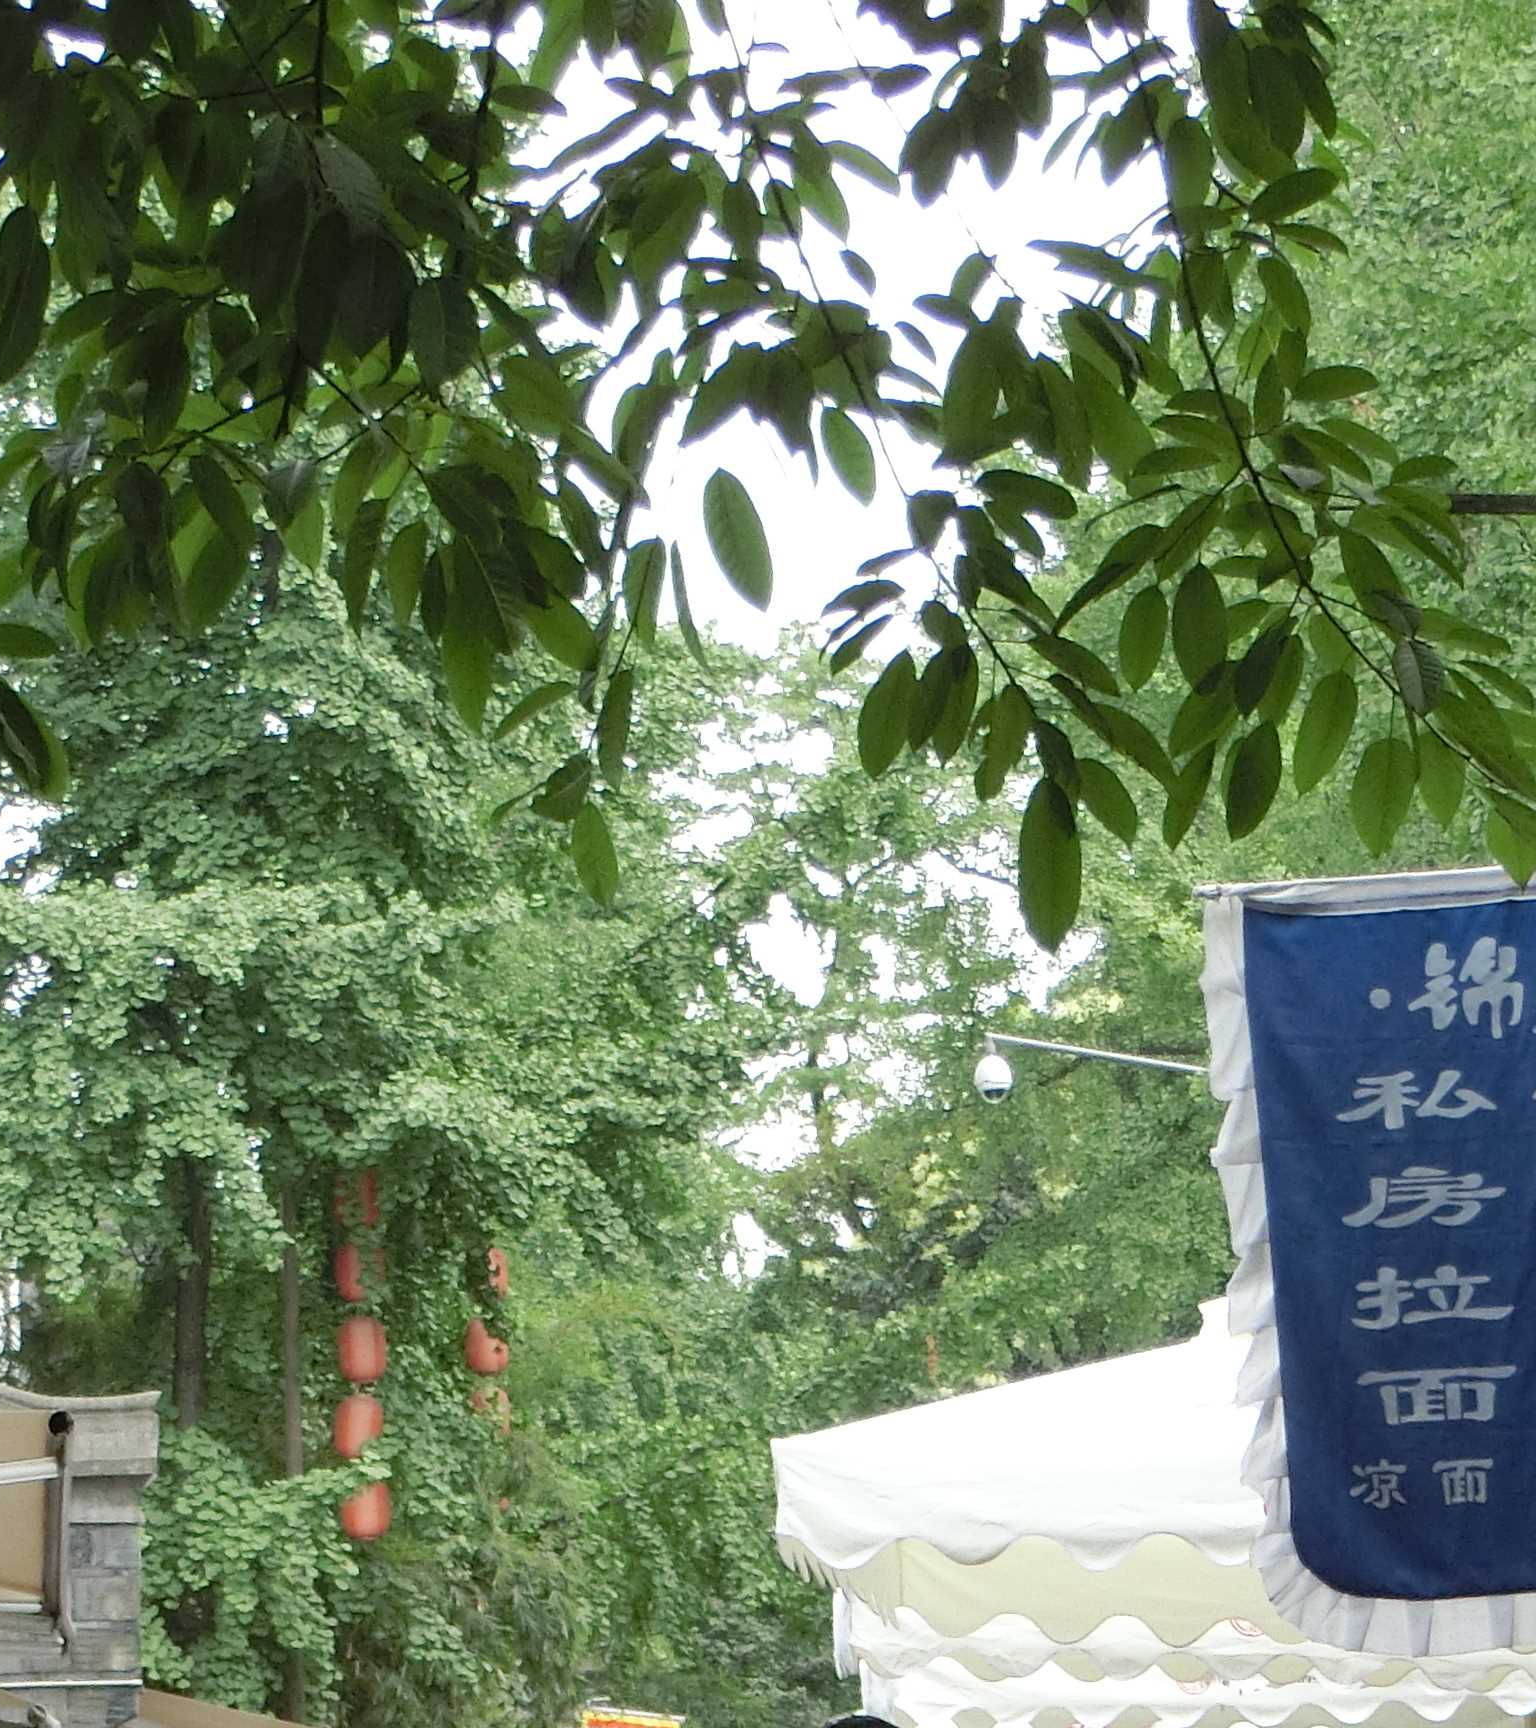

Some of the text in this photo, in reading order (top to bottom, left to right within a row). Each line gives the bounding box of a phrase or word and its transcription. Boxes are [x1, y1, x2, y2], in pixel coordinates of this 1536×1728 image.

[1336, 1069, 1520, 1425] 私房拉面
[1349, 1457, 1495, 1510] 凉面
